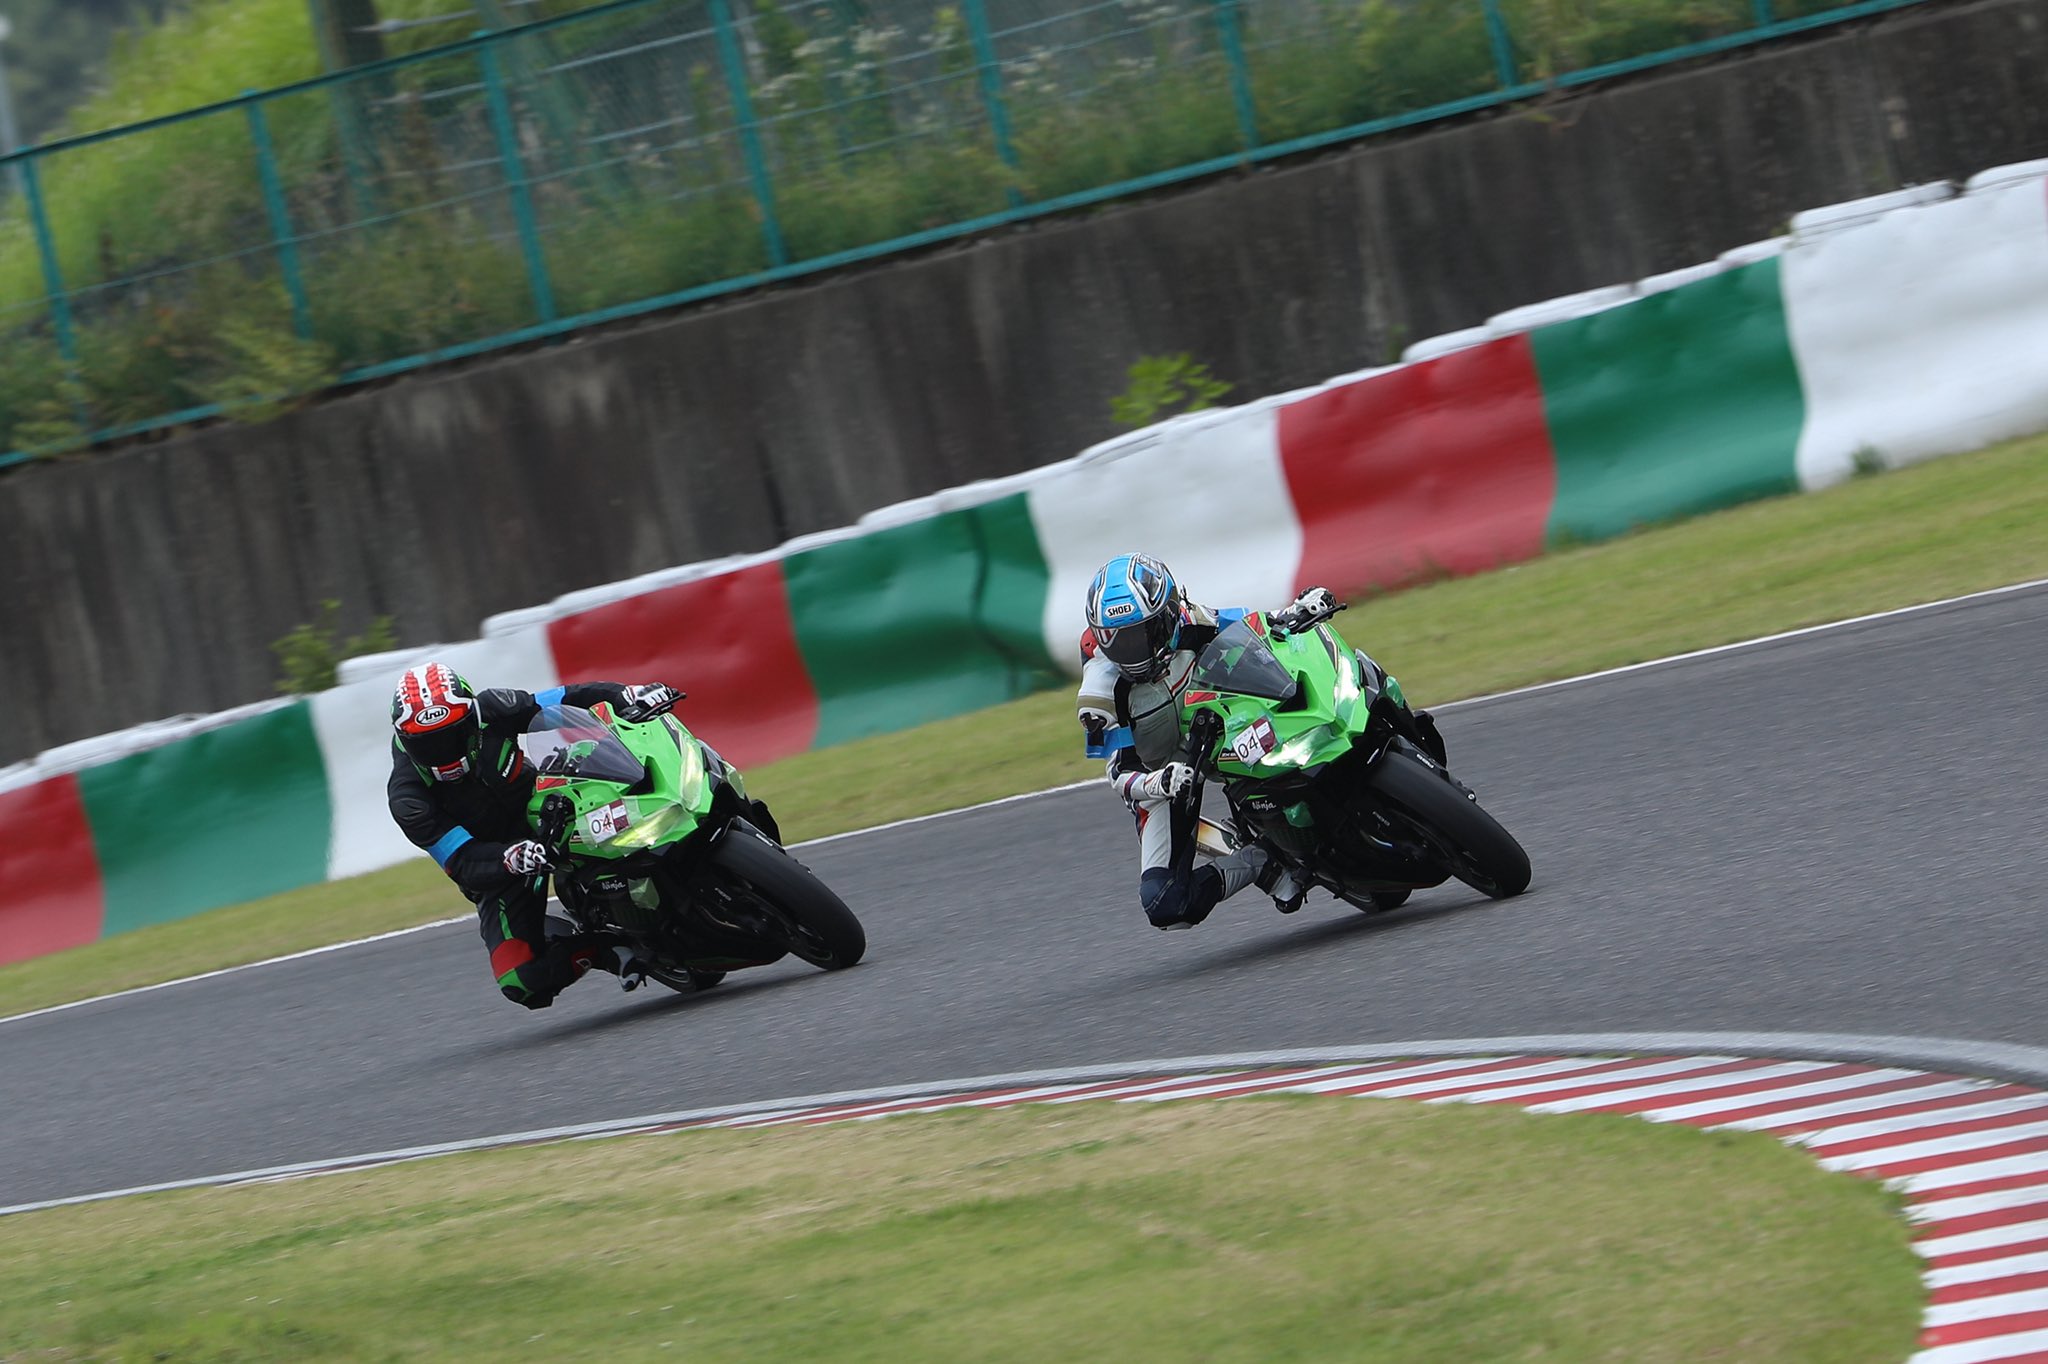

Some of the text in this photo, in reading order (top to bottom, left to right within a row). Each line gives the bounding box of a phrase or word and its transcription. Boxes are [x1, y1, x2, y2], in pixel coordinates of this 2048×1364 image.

[1107, 604, 1132, 617] SHOEI
[419, 707, 446, 722] Arai
[1237, 734, 1259, 758] 04
[1251, 800, 1276, 812] Ninja
[591, 813, 612, 834] 04
[601, 879, 626, 891] Ninja
